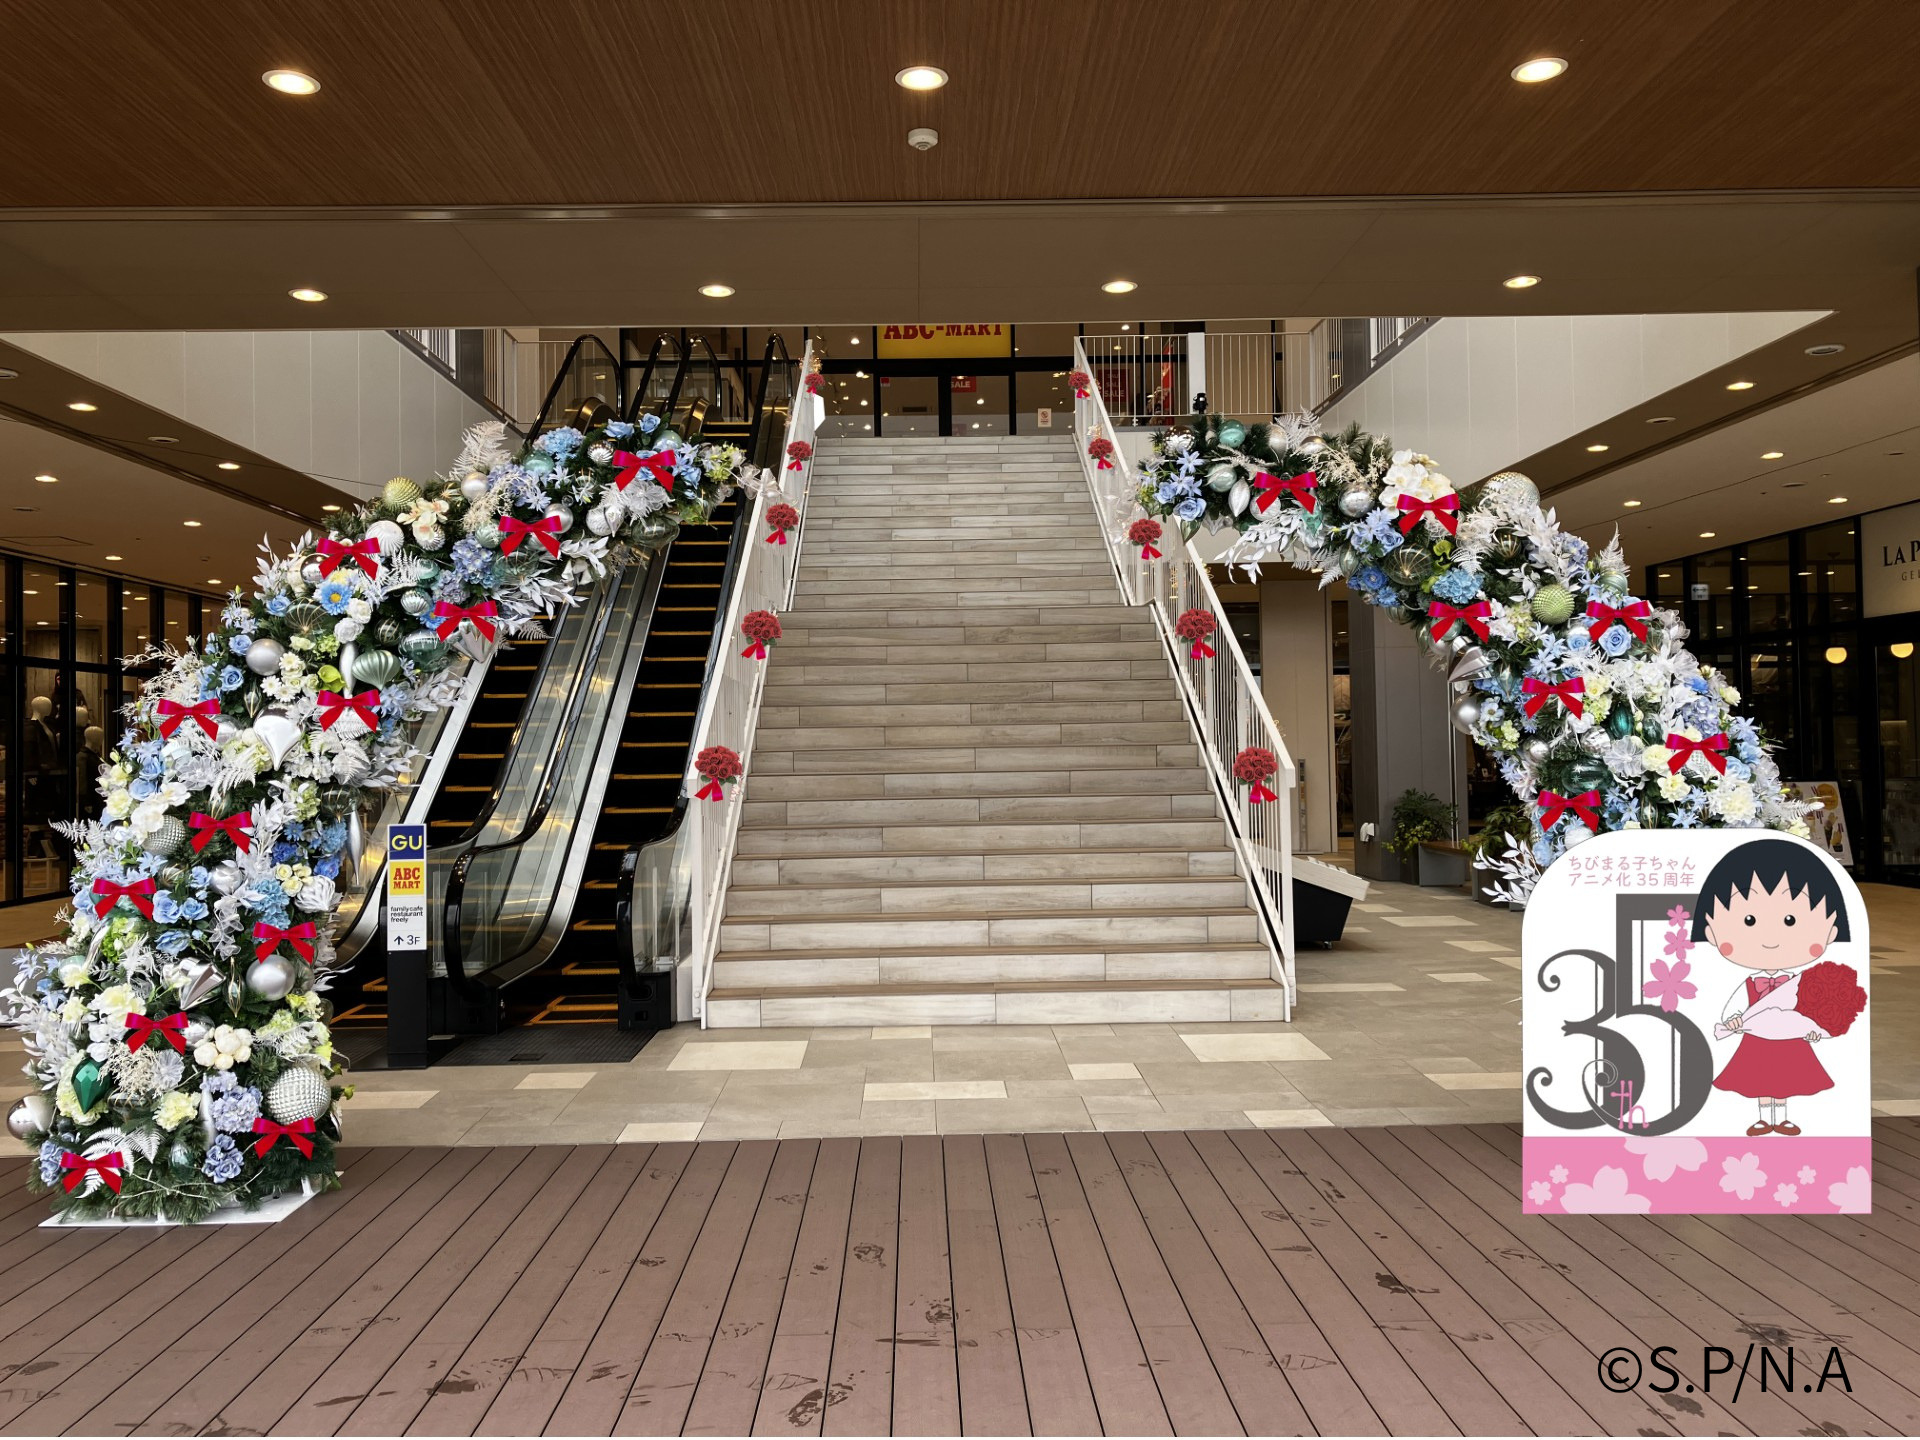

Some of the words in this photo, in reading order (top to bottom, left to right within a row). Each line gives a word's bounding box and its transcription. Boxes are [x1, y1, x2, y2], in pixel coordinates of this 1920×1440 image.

[883, 324, 1002, 340] ABC-MART
[1883, 545, 1906, 567] LA
[1901, 569, 1920, 581] GE
[391, 834, 423, 851] GU
[1568, 856, 1696, 871] ちびまる子ちゃん
[393, 867, 421, 881] ABC
[393, 880, 421, 889] MART
[406, 934, 421, 945] 3F
